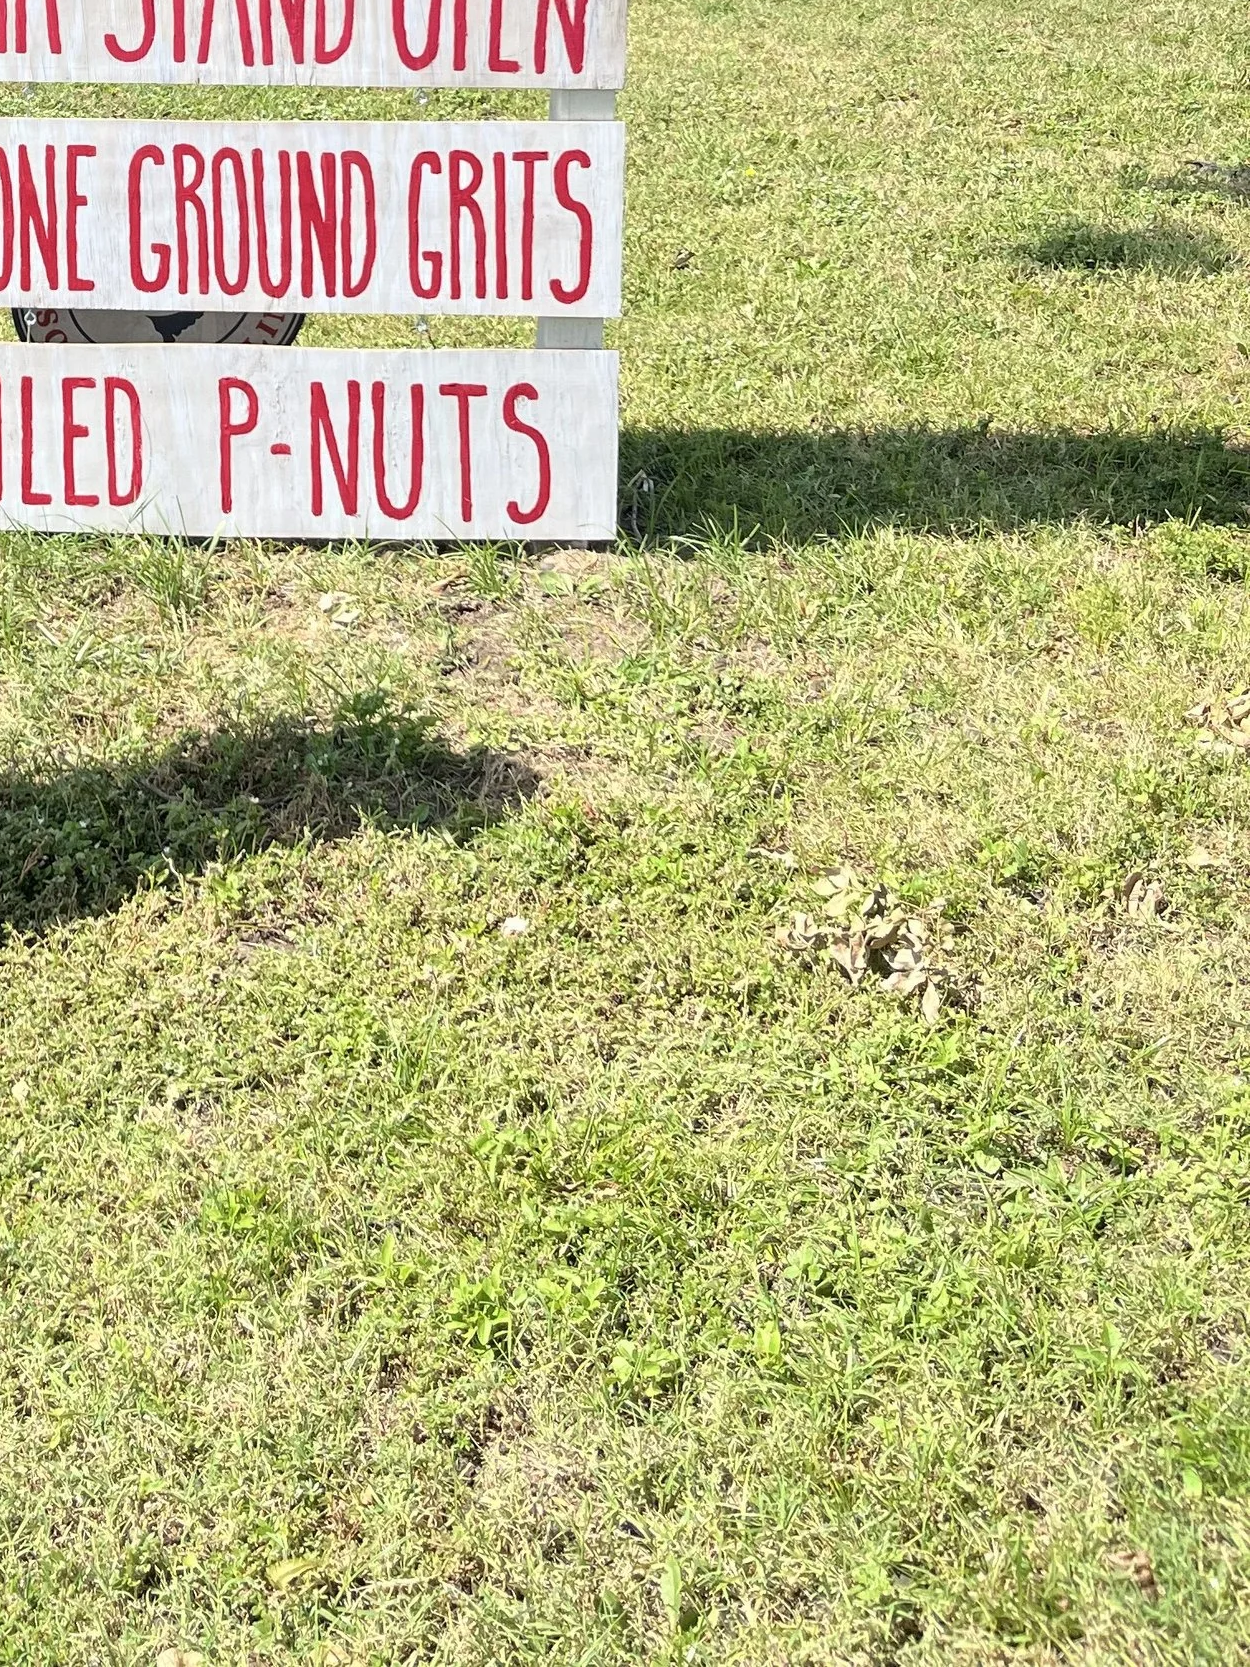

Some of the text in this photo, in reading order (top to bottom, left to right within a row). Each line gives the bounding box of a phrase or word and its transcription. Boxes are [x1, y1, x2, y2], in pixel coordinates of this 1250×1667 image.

[128, 143, 377, 299] GROUND
[408, 149, 593, 304] GRITS
[218, 377, 551, 525] P-NUTS
